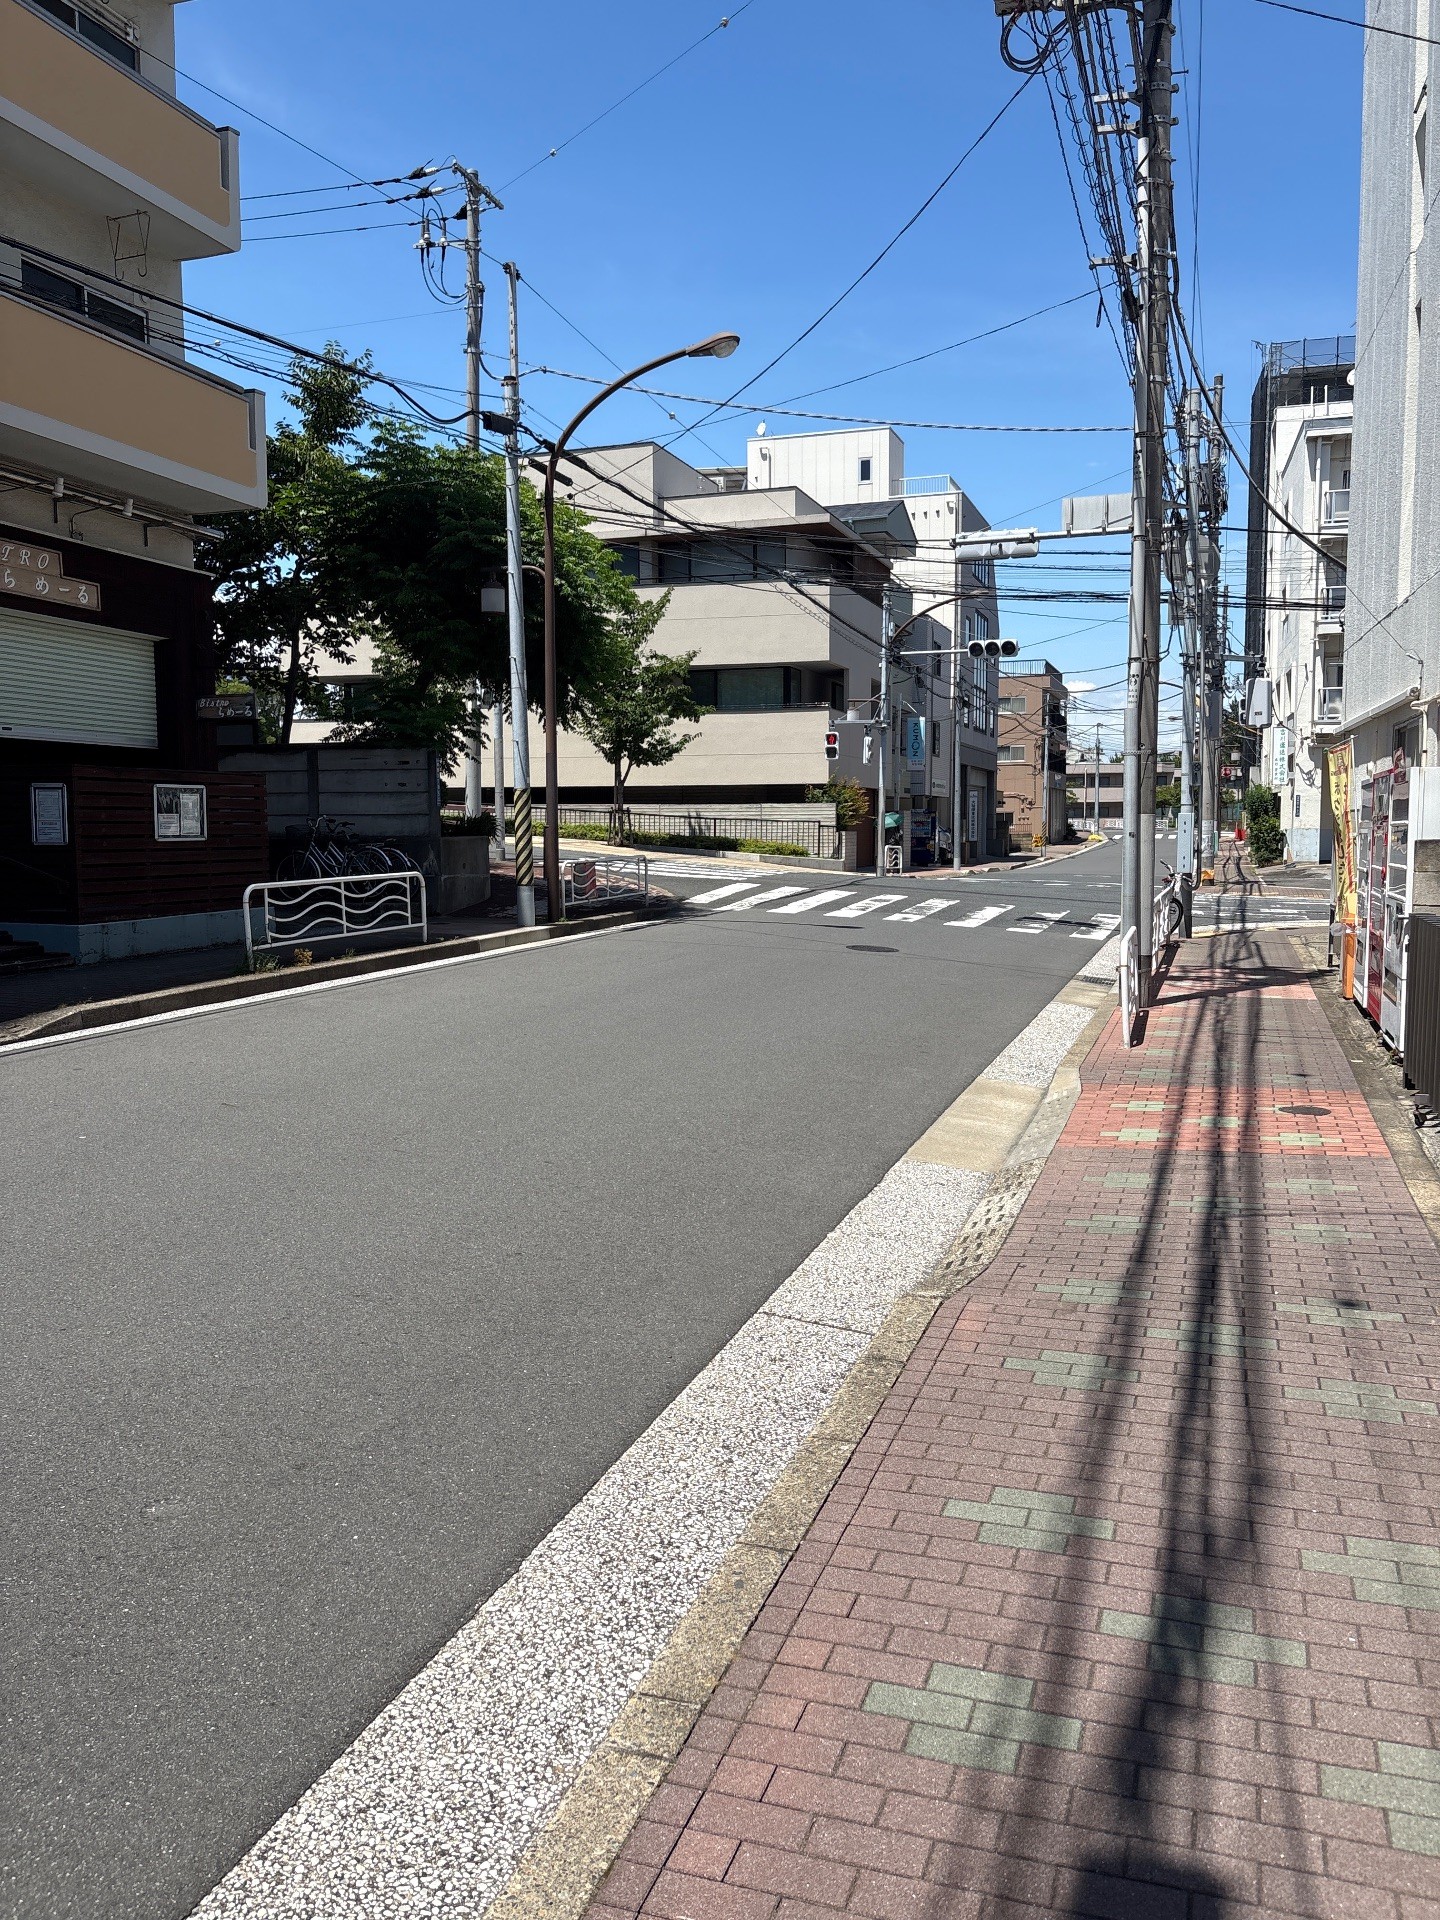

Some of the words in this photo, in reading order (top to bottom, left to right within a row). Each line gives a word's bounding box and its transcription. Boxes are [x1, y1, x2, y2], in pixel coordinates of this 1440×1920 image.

[1, 545, 49, 569] TRO
[4, 568, 89, 604] らめーる
[199, 698, 230, 708] Bistro
[218, 705, 253, 718] らめーる
[911, 722, 920, 757] KUMON
